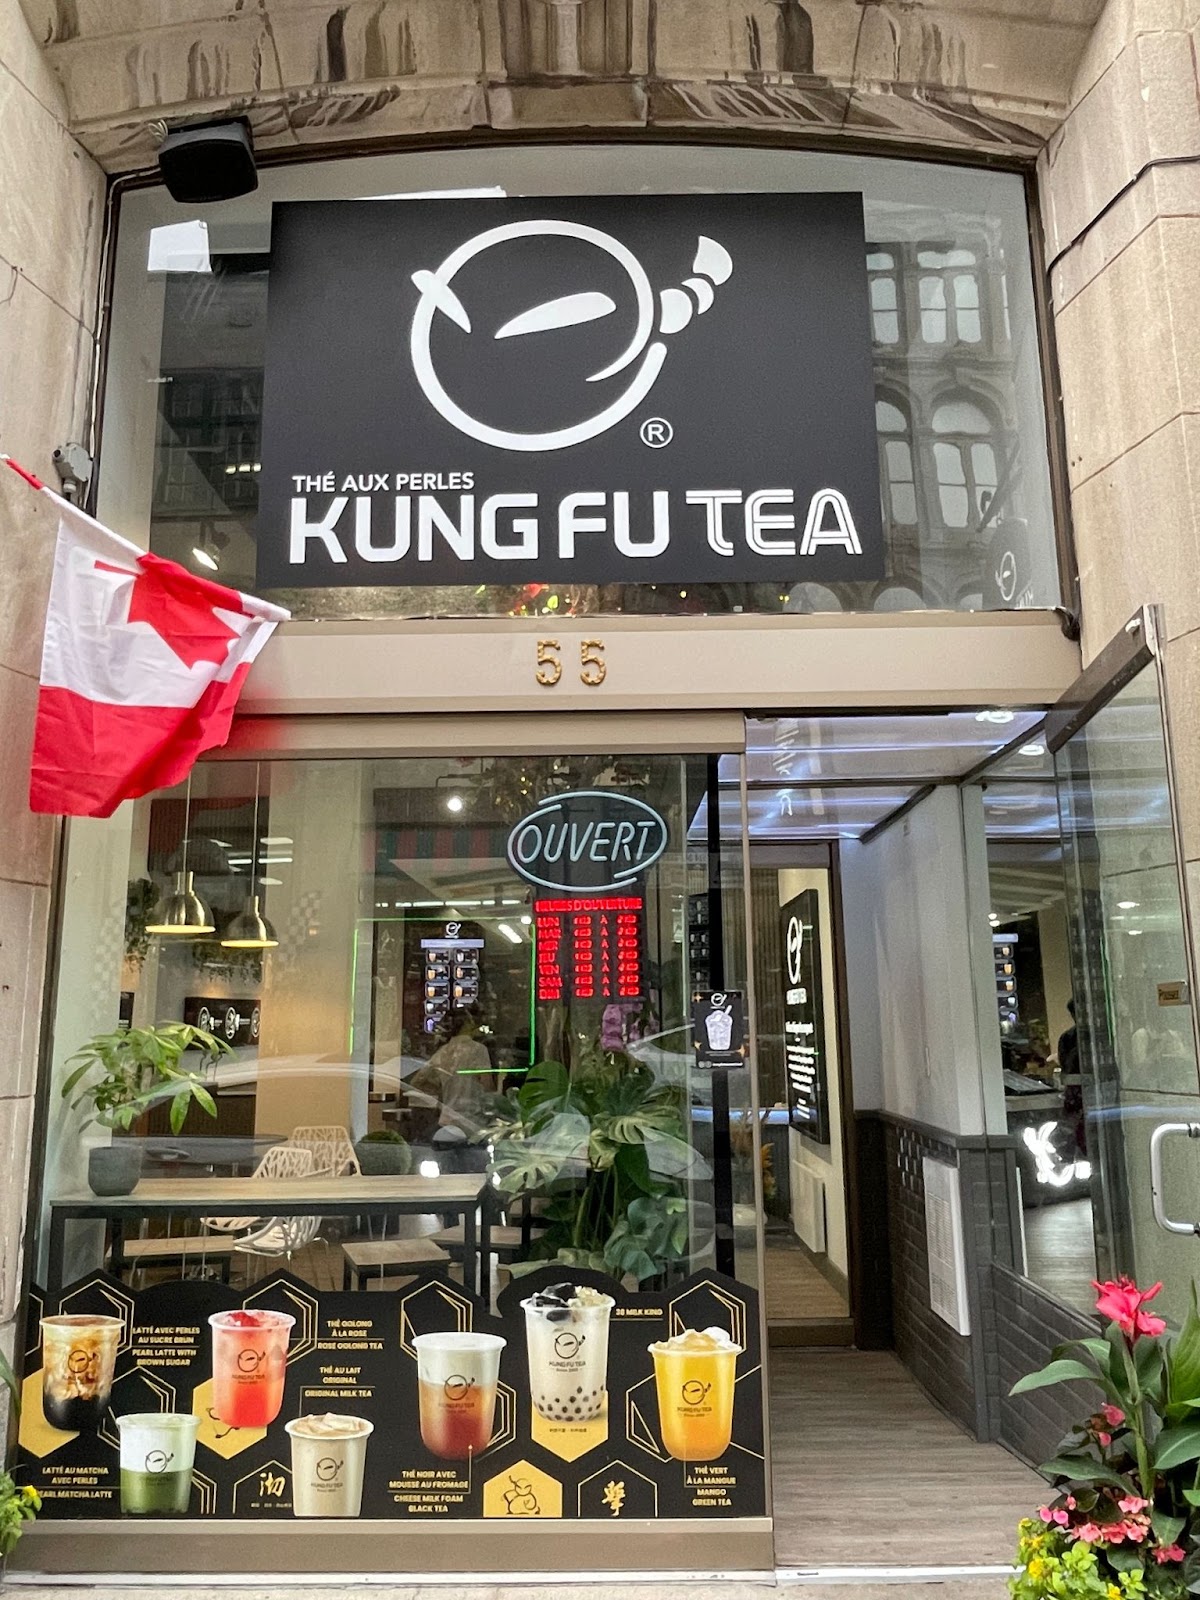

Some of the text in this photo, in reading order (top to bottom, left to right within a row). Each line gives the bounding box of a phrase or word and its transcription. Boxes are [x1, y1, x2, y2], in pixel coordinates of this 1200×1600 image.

[292, 470, 475, 493] THÉ AUX PERLES
[289, 488, 863, 564] KUNG FU TEA
[516, 821, 656, 864] OUVERT
[369, 1342, 383, 1350] TEA
[39, 1490, 57, 1498] EARL
